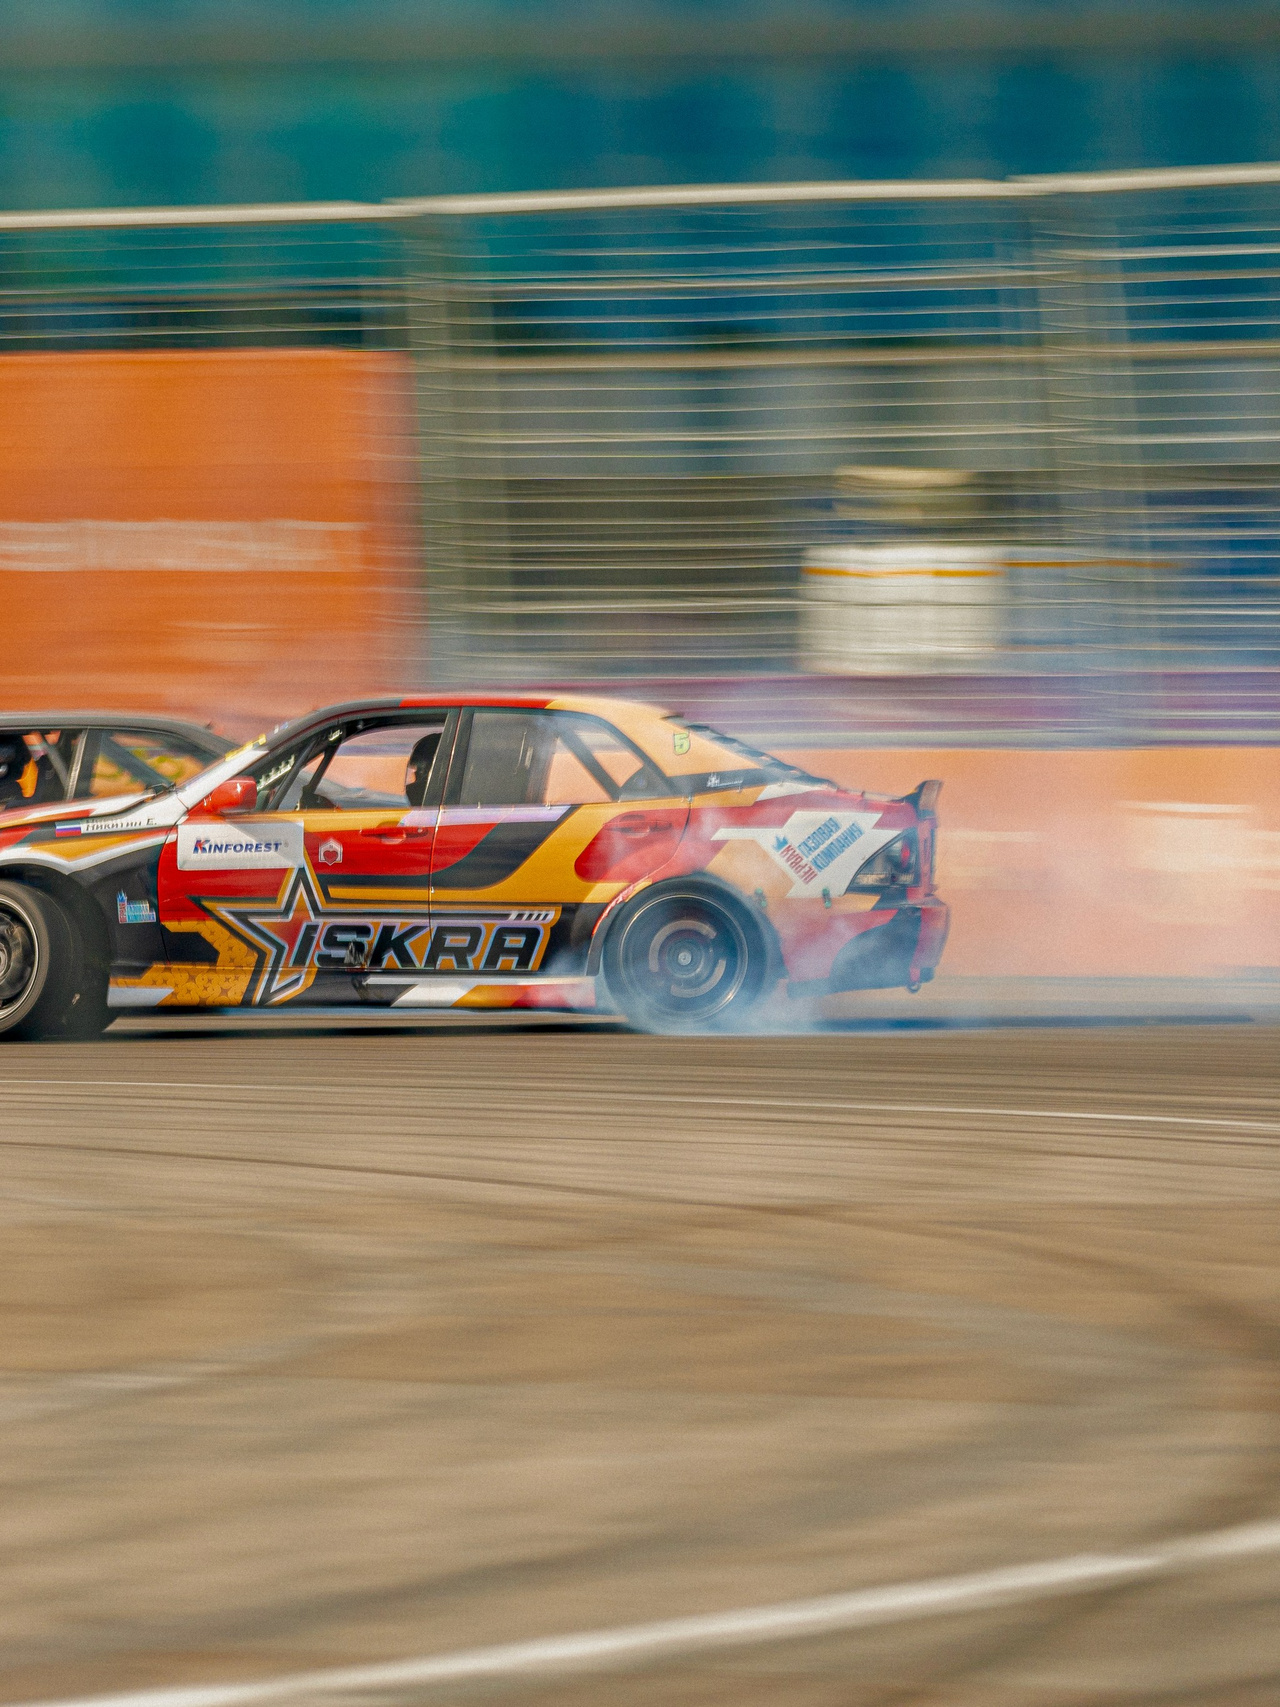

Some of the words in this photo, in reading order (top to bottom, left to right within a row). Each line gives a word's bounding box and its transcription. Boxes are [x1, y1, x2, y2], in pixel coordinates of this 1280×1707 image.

[673, 730, 690, 756] 5
[193, 838, 282, 854] KINFOREST
[797, 816, 841, 859] ГАЗОВАЯ
[810, 822, 865, 873] КОМПАНИЯ
[780, 844, 818, 885] ПЕРВАЯ
[288, 922, 543, 970] ISKRA
